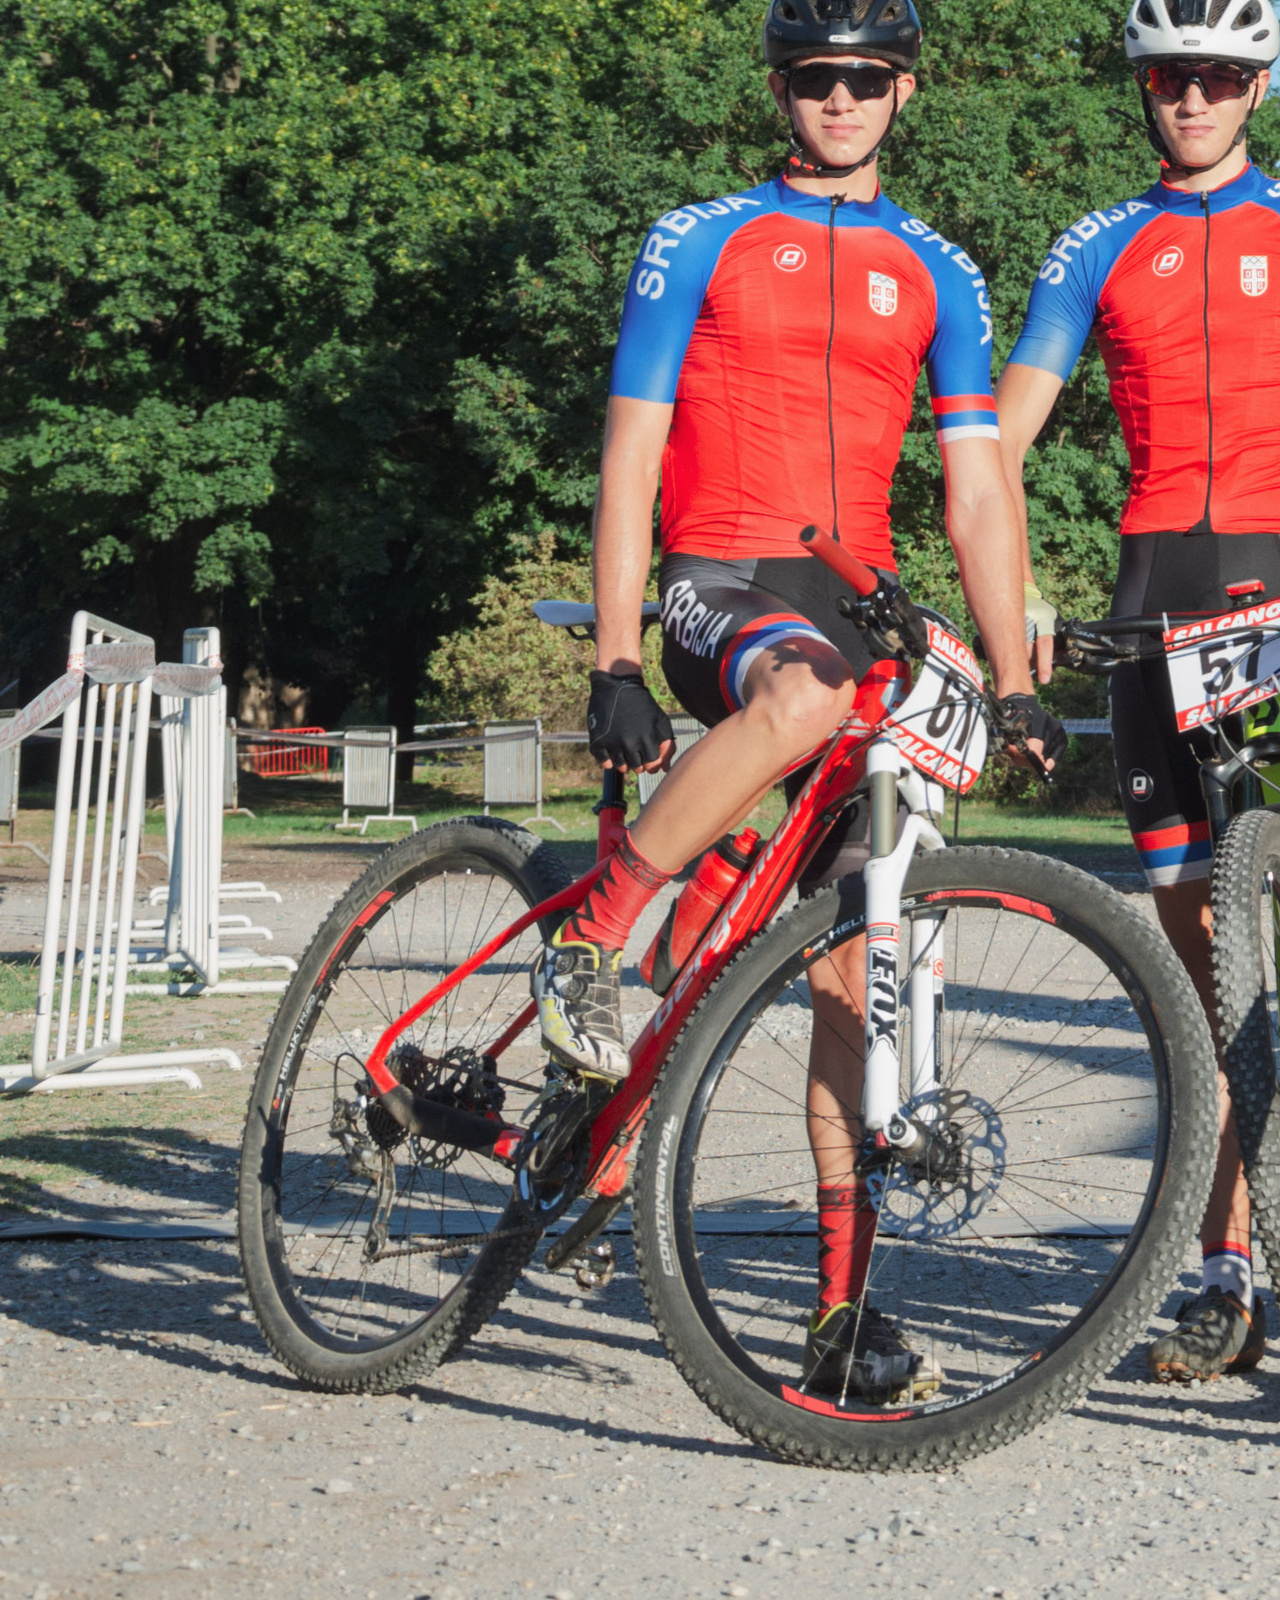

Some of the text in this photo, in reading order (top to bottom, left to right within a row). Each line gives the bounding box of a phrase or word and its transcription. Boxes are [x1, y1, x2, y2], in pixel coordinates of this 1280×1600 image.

[635, 193, 762, 300] SRBIJA
[900, 217, 993, 346] SRBIJA
[1038, 200, 1152, 286] SRBIJA
[659, 579, 734, 660] SRBIJA
[932, 630, 984, 687] SALCANO
[1200, 631, 1264, 695] 57
[882, 725, 972, 786] SALCANO
[655, 1114, 676, 1278] CONTINENTAL
